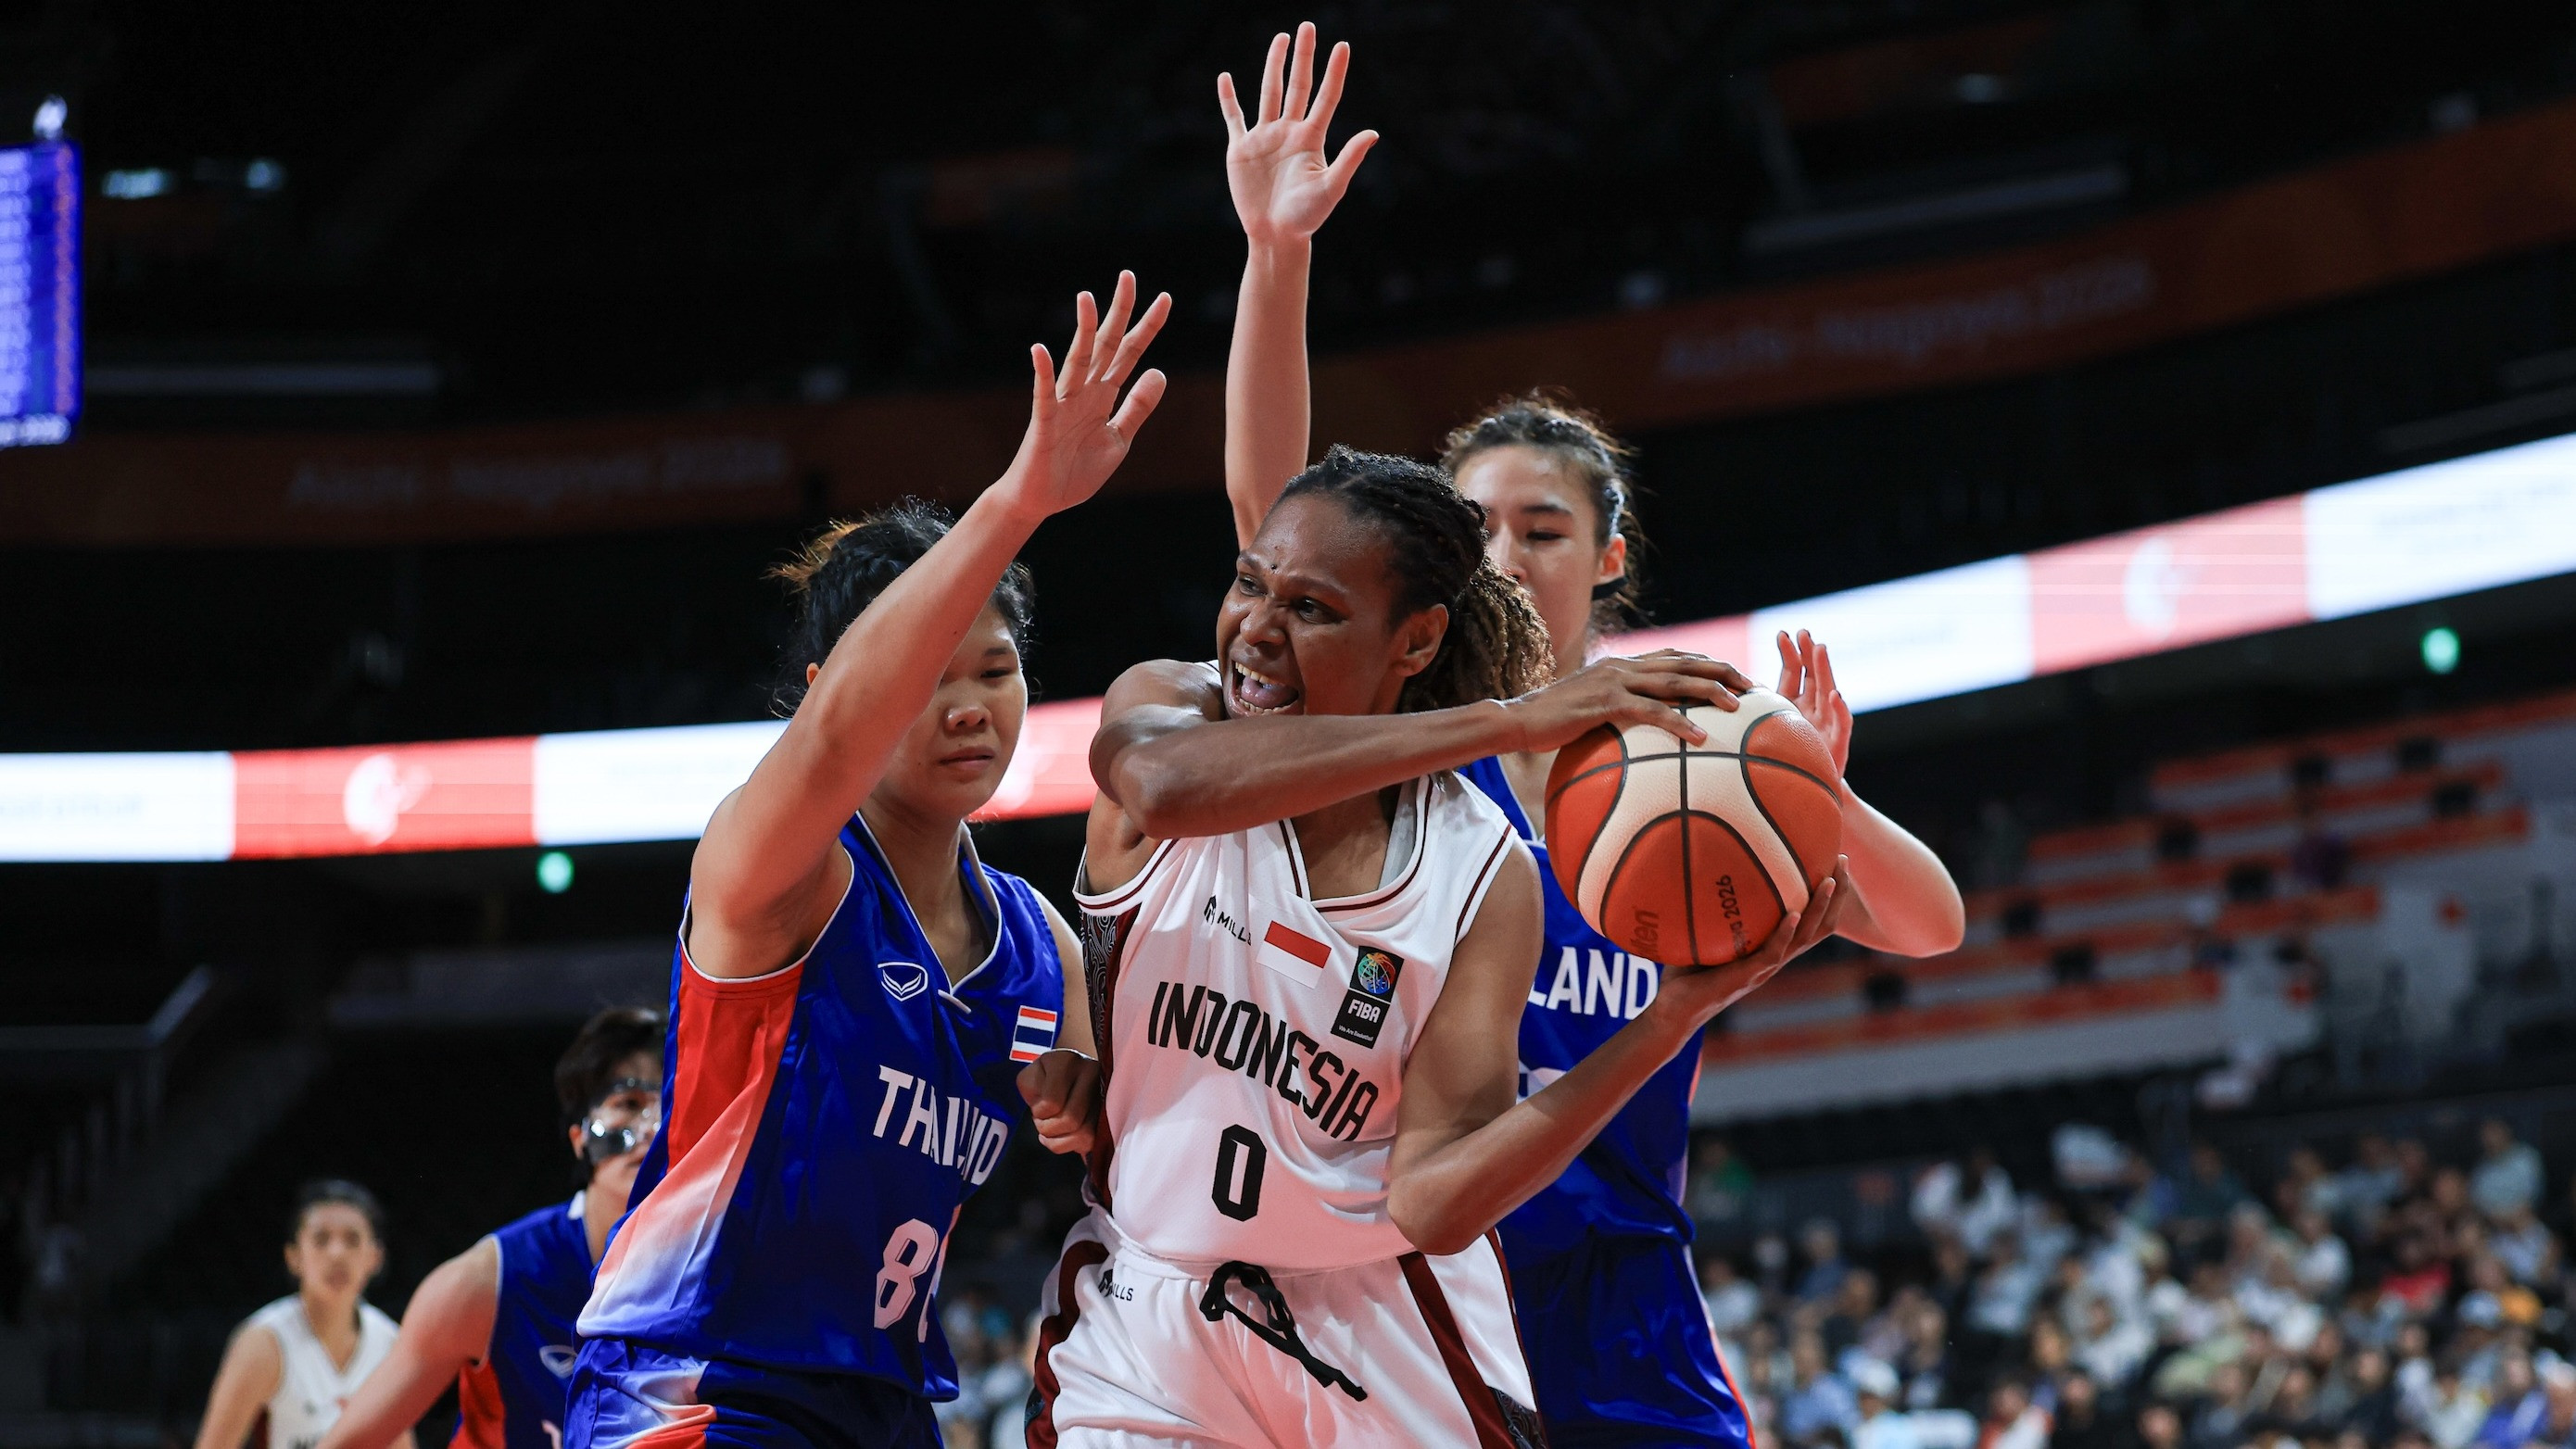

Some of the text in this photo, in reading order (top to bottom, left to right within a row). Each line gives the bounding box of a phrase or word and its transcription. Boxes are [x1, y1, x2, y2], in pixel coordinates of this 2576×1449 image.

[1716, 874, 1741, 919] 2026
[1347, 999, 1381, 1023] FIBA
[1148, 981, 1379, 1141] INDONESIA
[1212, 1124, 1267, 1222] 0
[874, 1218, 938, 1342] 8
